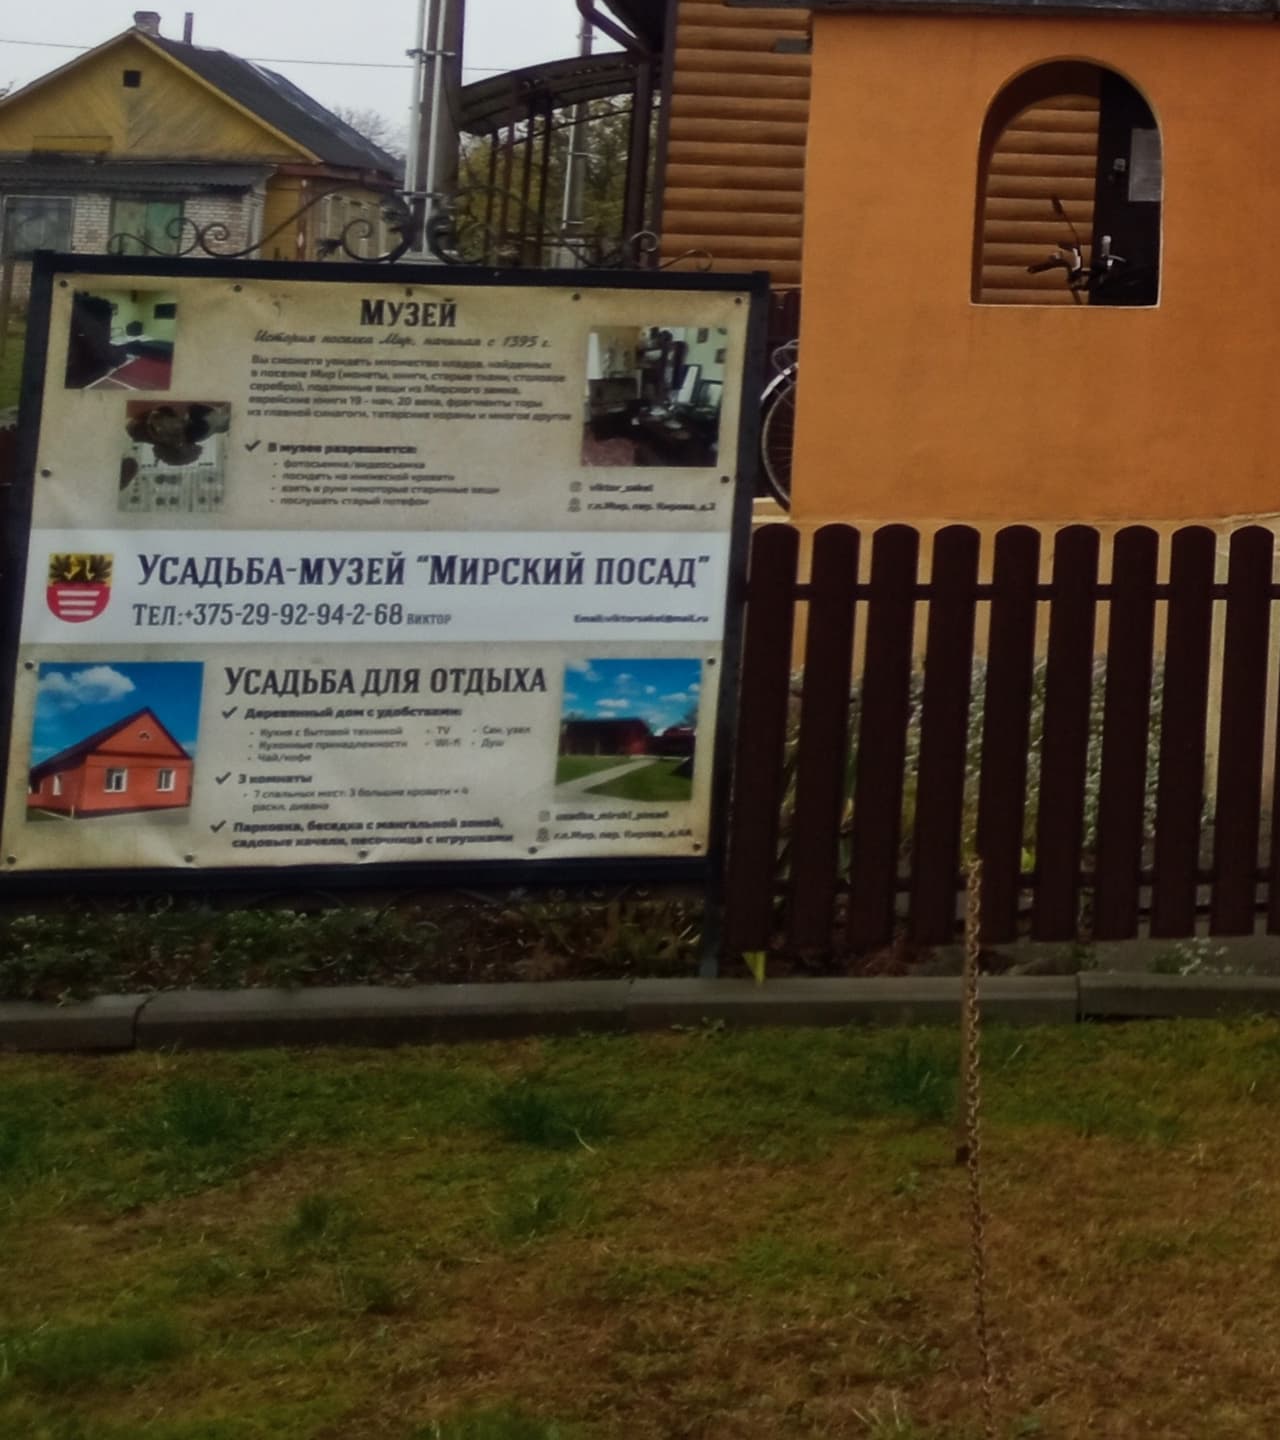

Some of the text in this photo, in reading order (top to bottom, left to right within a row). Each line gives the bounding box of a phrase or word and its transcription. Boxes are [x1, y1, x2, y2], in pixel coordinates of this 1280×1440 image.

[360, 297, 457, 327] МУЗЕЙ
[503, 335, 539, 348] 1395
[137, 551, 710, 588] УСАДЬБА-МУЗЕЙ "МИРСКИЙ ПОСАД"
[224, 665, 547, 696] УСАДЬБА ДЛЯ ОТДЫХА
